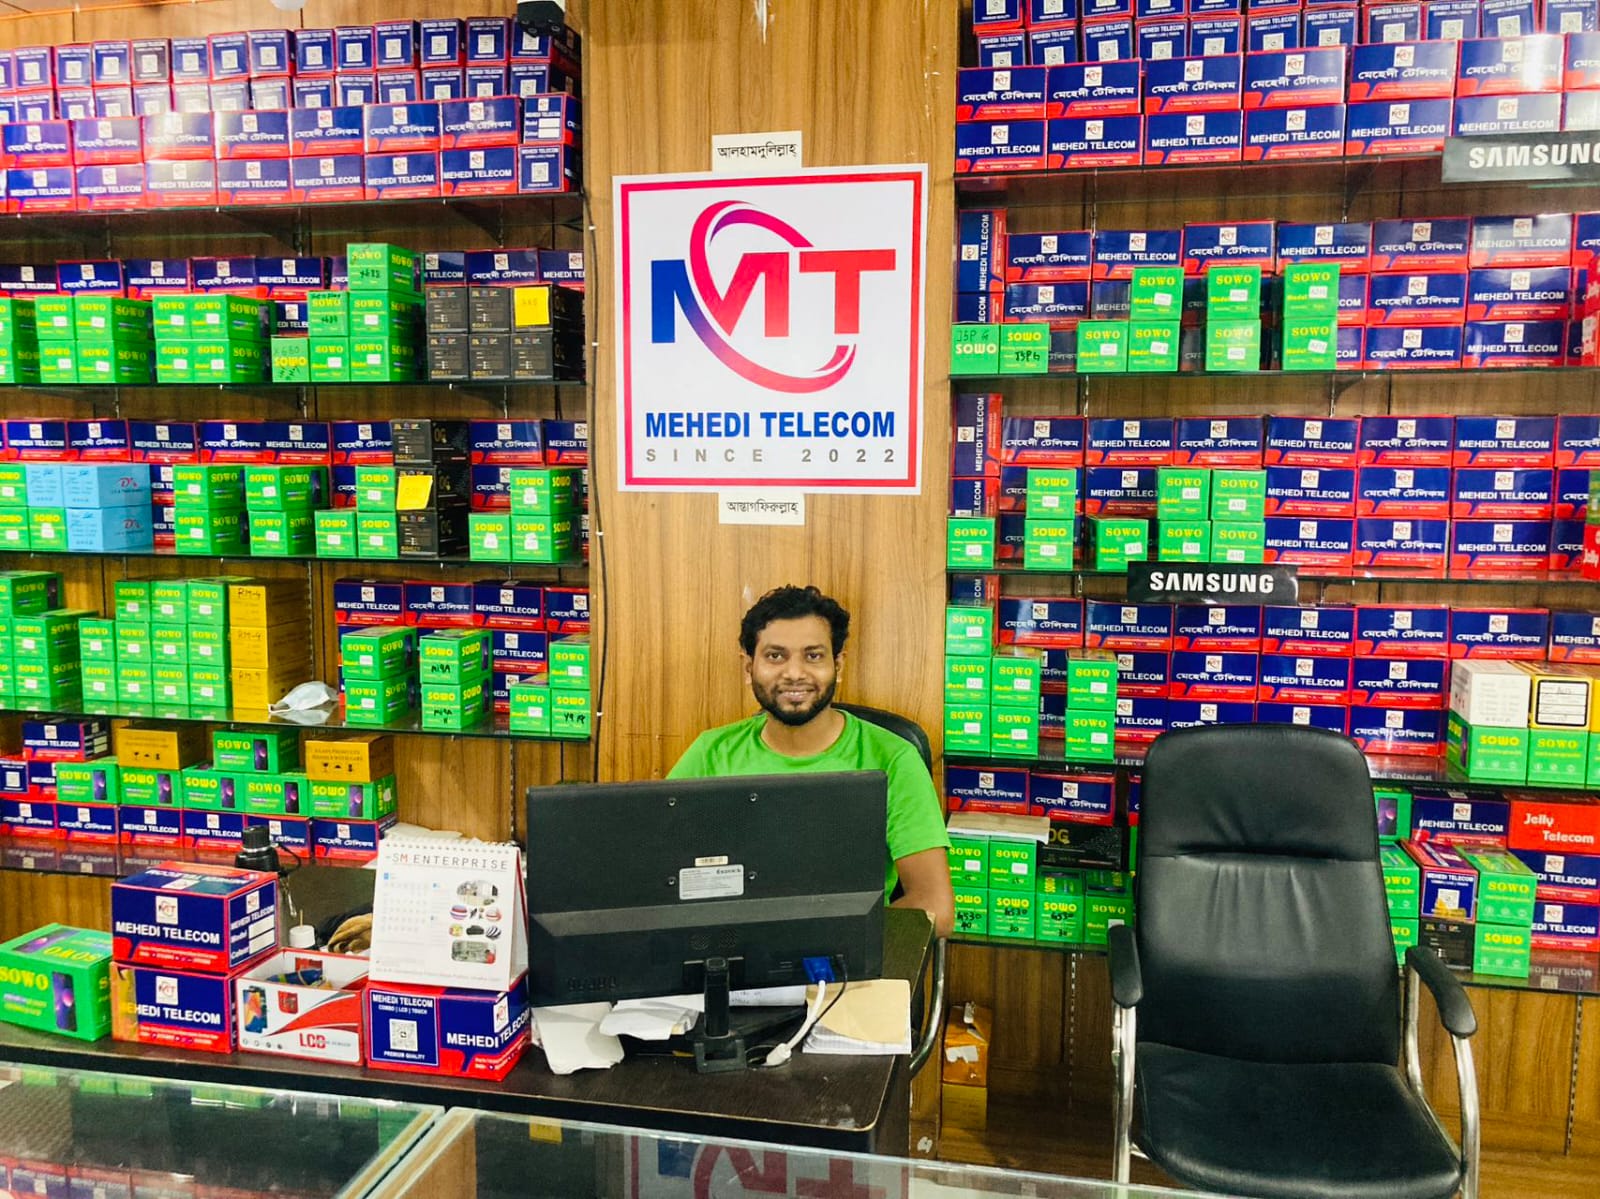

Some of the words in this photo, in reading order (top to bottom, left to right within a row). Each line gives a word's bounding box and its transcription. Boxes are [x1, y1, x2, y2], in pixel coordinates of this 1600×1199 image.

[1402, 68, 1449, 78] টেলিকম
[1459, 122, 1501, 131] MEHEDI
[1502, 120, 1556, 129] TELECOM
[1352, 127, 1392, 137] MEHEDI
[1395, 125, 1446, 135] TELECOM
[1250, 133, 1289, 143] MEHEDI
[1292, 130, 1342, 140] TELECOM
[959, 147, 994, 155] MEHEDI
[996, 145, 1040, 154] TELECOM
[1052, 142, 1088, 150] MEHEDI
[1090, 141, 1135, 149] TELECOM
[442, 171, 472, 179] MEHEDI
[474, 169, 512, 178] TELECOM
[251, 180, 287, 188] TELECOM
[295, 178, 323, 186] MEHEDI
[325, 176, 360, 184] TELECOM
[980, 214, 989, 253] TELECOM
[1282, 247, 1317, 256] MEHEDI
[1320, 246, 1366, 254] TELECOM
[1098, 253, 1131, 261] MEHEDI
[1134, 253, 1176, 261] TELECOM
[543, 271, 570, 279] MEHEDI
[980, 255, 989, 291] MEHEDI
[1474, 292, 1513, 301] MEHEDI
[1515, 291, 1564, 300] TELECOM
[115, 305, 144, 316] SOWO
[158, 302, 185, 310] SOWO
[1008, 332, 1042, 341] SOWO
[956, 344, 998, 354] SOWO
[1468, 344, 1506, 352] MEHEDI
[1509, 344, 1557, 352] TELECOM
[646, 411, 750, 438] MEHEDI
[760, 411, 895, 438] TELECOM
[1092, 440, 1126, 448] MEHEDI
[1270, 439, 1306, 448] MEHEDI
[1308, 441, 1352, 449] TELECOM
[1365, 440, 1402, 448] মেহেদী
[1405, 440, 1448, 448] টেলিকম
[1459, 439, 1498, 448] MEHEDI
[1500, 440, 1549, 448] TELECOM
[646, 448, 764, 463] SINCE
[801, 448, 895, 463] 2022
[178, 472, 202, 480] SOWO
[552, 476, 570, 486] SOWO
[516, 478, 544, 486] SOWO
[1268, 488, 1303, 497] MEHEDI
[1305, 490, 1349, 498] TELECOM
[1231, 500, 1244, 510] A10
[34, 514, 60, 525] SOWO
[954, 528, 988, 536] SOWO
[1230, 552, 1243, 560] A10
[1149, 571, 1275, 594] SAMSUNG
[951, 614, 985, 626] SOWO
[1089, 624, 1123, 632] MEHEDI
[1268, 628, 1303, 636] MEHEDI
[1456, 634, 1494, 642] মেহেদী
[426, 647, 453, 656] SOWO
[556, 652, 584, 661] SOWO
[952, 664, 985, 673] SOWO
[1264, 676, 1298, 684] MEHEDI
[1300, 678, 1344, 686] TELECOM
[217, 740, 250, 750] SOWO
[1480, 736, 1520, 746] SOWO
[1538, 738, 1578, 749] SOWO
[58, 771, 92, 780] SOWO
[123, 773, 154, 784] SOWO
[1524, 813, 1554, 827] Jelly
[123, 823, 147, 831] MEHEDI
[1418, 820, 1455, 828] MEHEDI
[1458, 823, 1503, 831] TELECOM
[1543, 830, 1594, 844] Telecom
[947, 846, 981, 856] SOWO
[996, 850, 1028, 859] SOWO
[413, 854, 509, 871] ENTERPRISE
[1546, 874, 1596, 886] TELECOM
[952, 893, 982, 906] OWO
[997, 898, 1029, 908] SOWO
[1044, 902, 1076, 912] SOWO
[231, 914, 251, 930] MEHEDI
[251, 905, 274, 922] TELECOM
[116, 921, 159, 938] MEHEDI
[162, 926, 220, 944] TELECOM
[1546, 922, 1595, 934] TELECOM
[0, 966, 48, 990] SOWO
[372, 993, 398, 1004] MEHEDI
[400, 996, 433, 1008] TELECOM
[378, 1004, 394, 1012] COMBO
[399, 1006, 408, 1014] LCD
[162, 1007, 220, 1024] TELECOM
[446, 1032, 499, 1048] MEHEDI
[500, 1008, 531, 1044] TELECOM
[299, 1033, 326, 1049] LCD
